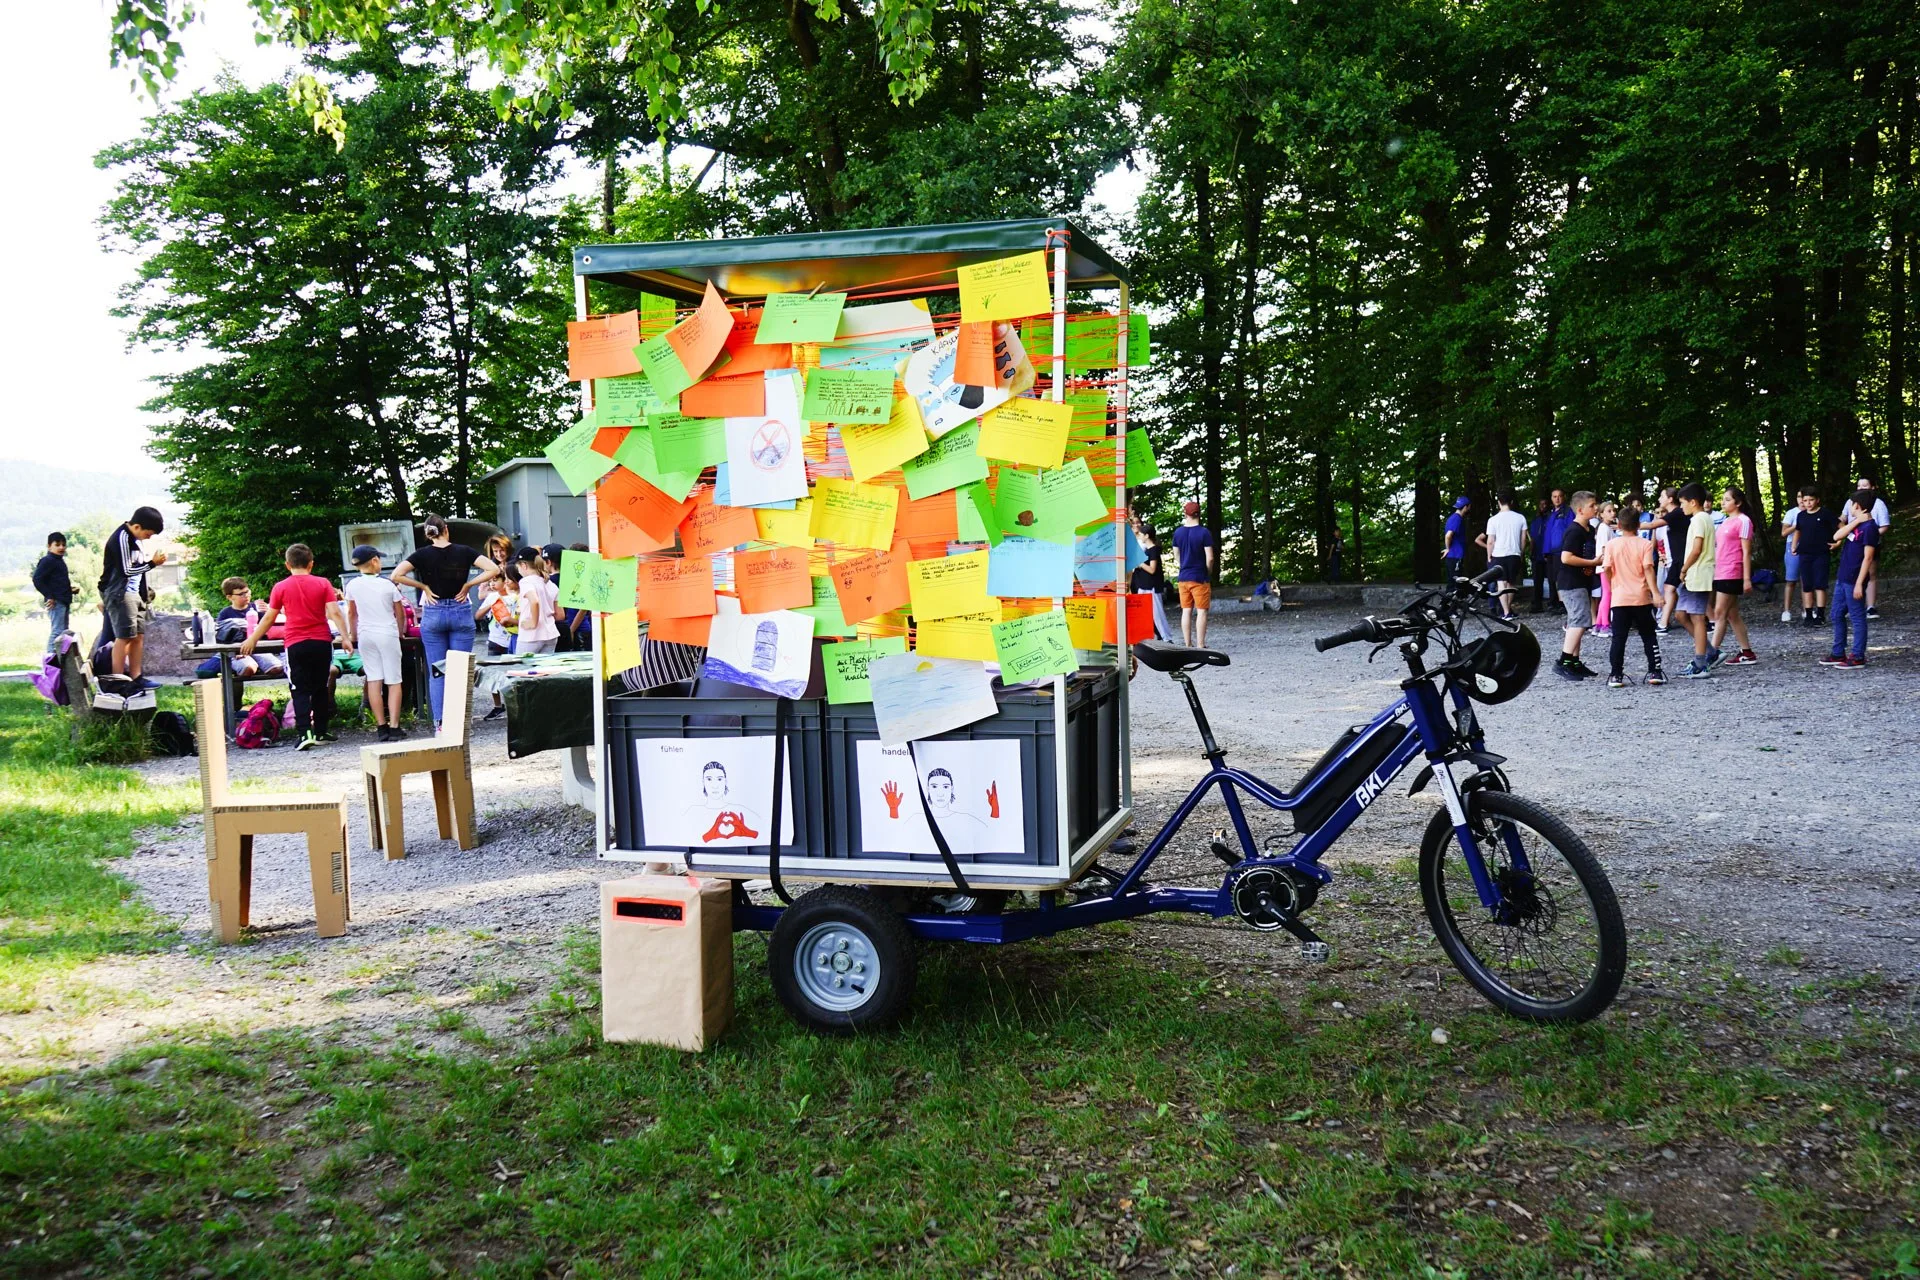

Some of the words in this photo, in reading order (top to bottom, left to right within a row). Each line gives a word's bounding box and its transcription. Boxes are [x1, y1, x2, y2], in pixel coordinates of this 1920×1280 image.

[660, 745, 684, 753] fühlen
[881, 747, 910, 756] handel
[1355, 771, 1391, 809] BKL
